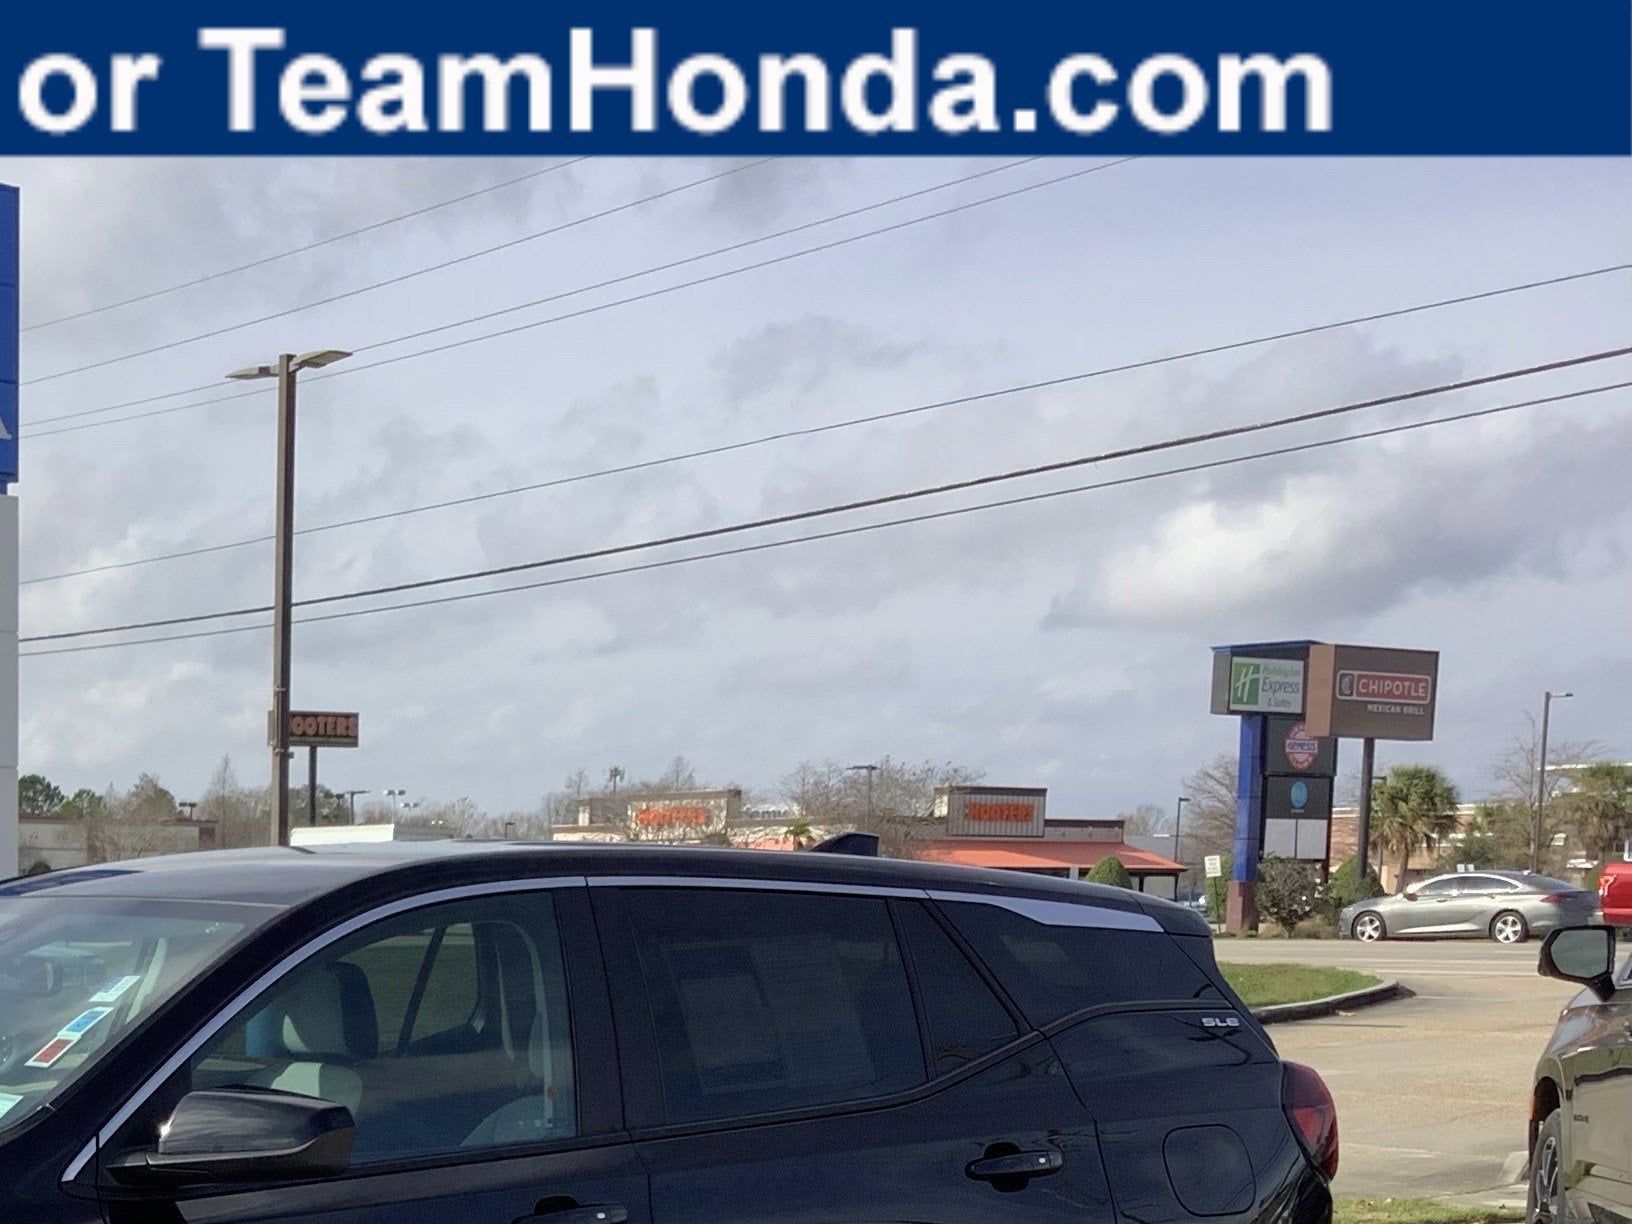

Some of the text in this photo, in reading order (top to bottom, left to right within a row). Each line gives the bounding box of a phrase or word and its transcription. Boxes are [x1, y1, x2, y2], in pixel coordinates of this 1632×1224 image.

[1262, 677, 1300, 695] Express
[1358, 679, 1426, 697] CHIPOTLE
[1367, 704, 1402, 714] MEXICAN
[290, 715, 357, 736] OOTERS
[1201, 1017, 1240, 1027] SLE
